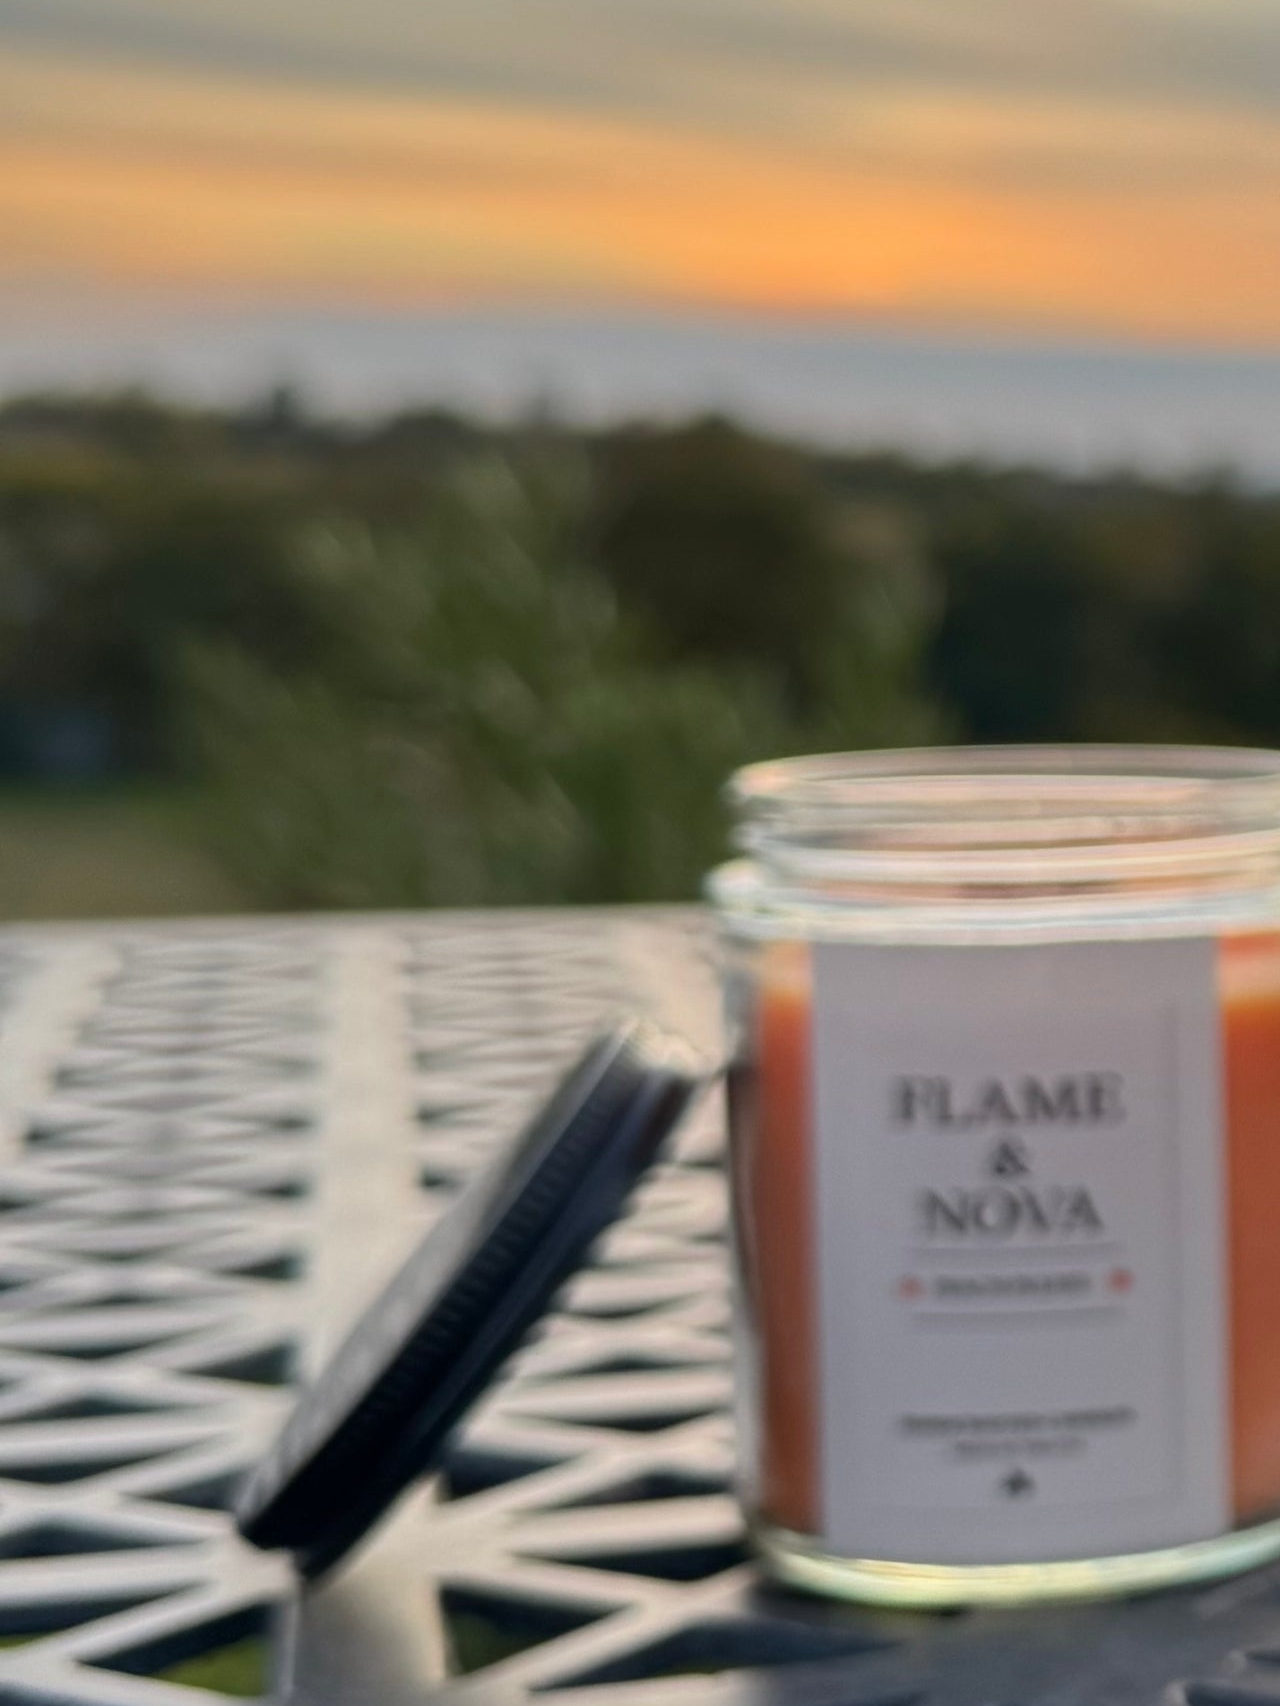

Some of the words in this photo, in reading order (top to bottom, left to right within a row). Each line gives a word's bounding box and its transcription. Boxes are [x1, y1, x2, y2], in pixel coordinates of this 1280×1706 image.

[893, 1073, 1127, 1129] FLAME
[986, 1134, 1030, 1180] &
[919, 1187, 1104, 1237] NOVA
